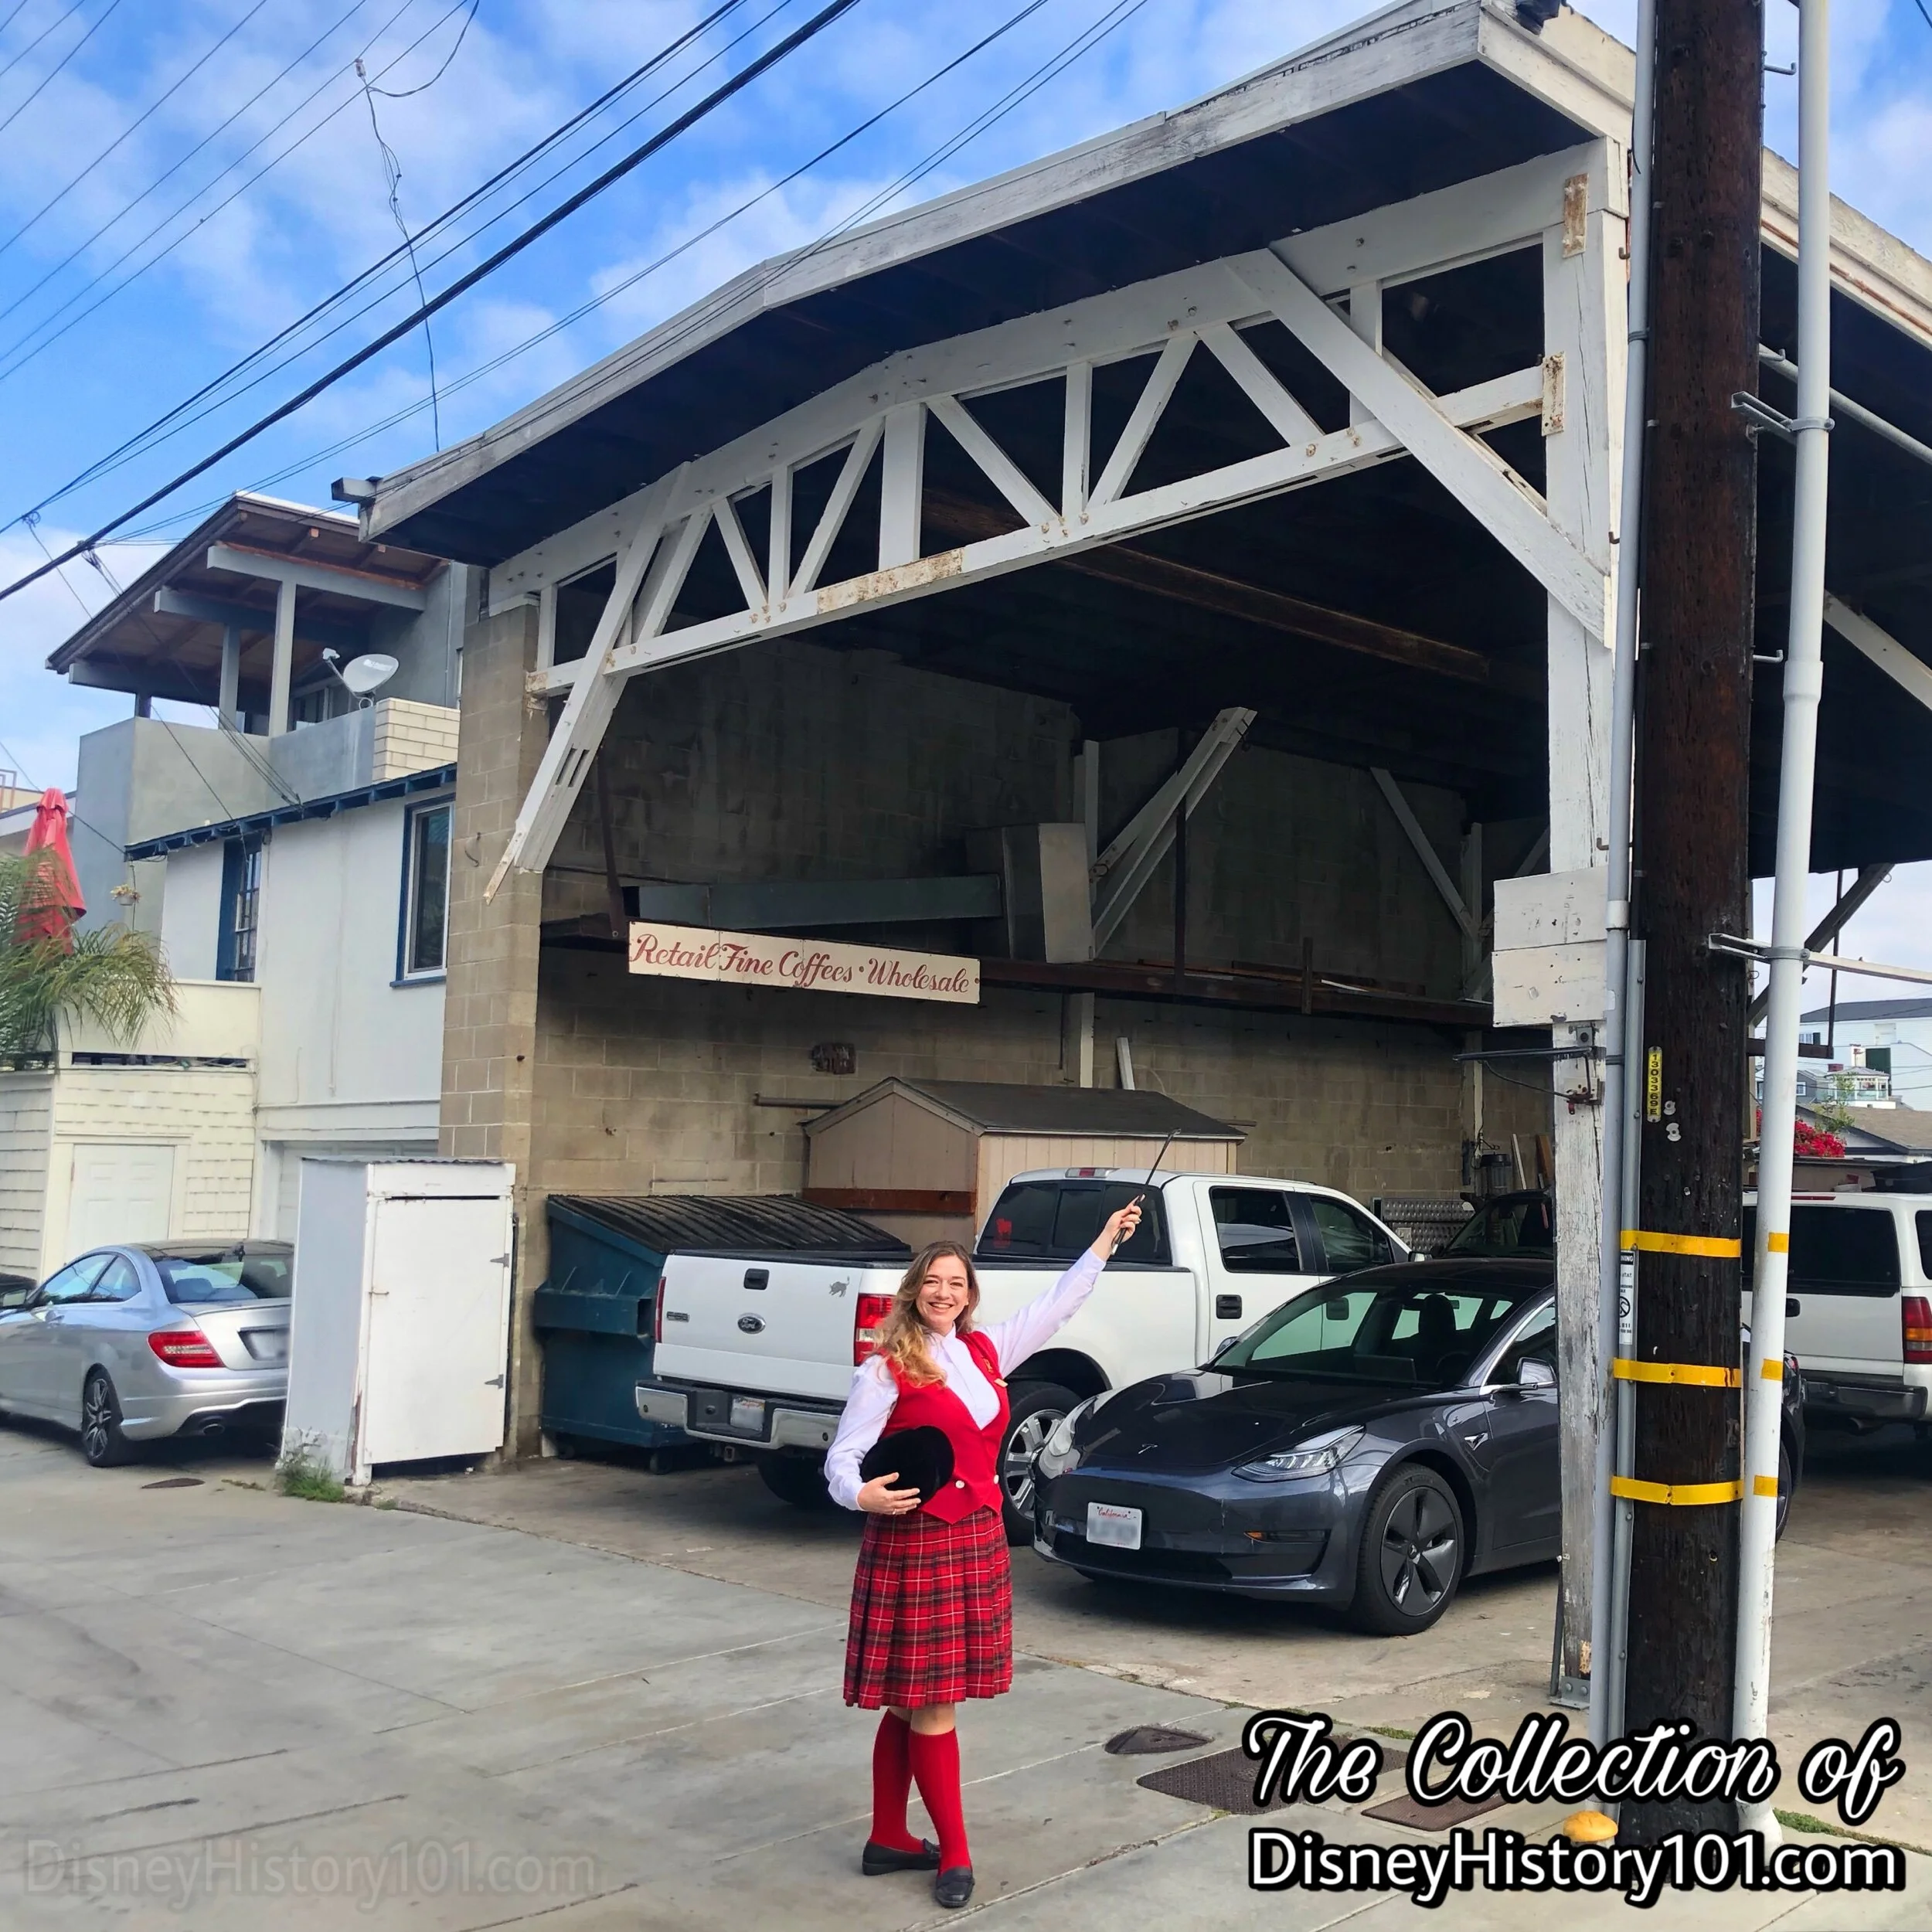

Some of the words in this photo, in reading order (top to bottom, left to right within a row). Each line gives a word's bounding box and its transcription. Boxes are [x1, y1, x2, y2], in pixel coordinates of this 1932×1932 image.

[629, 933, 721, 969] Retail
[719, 943, 774, 976] Fine
[778, 950, 853, 988] Coffees
[868, 957, 971, 994] Wholesale
[1650, 1054, 1660, 1115] 1303369E
[1098, 1507, 1128, 1519] California
